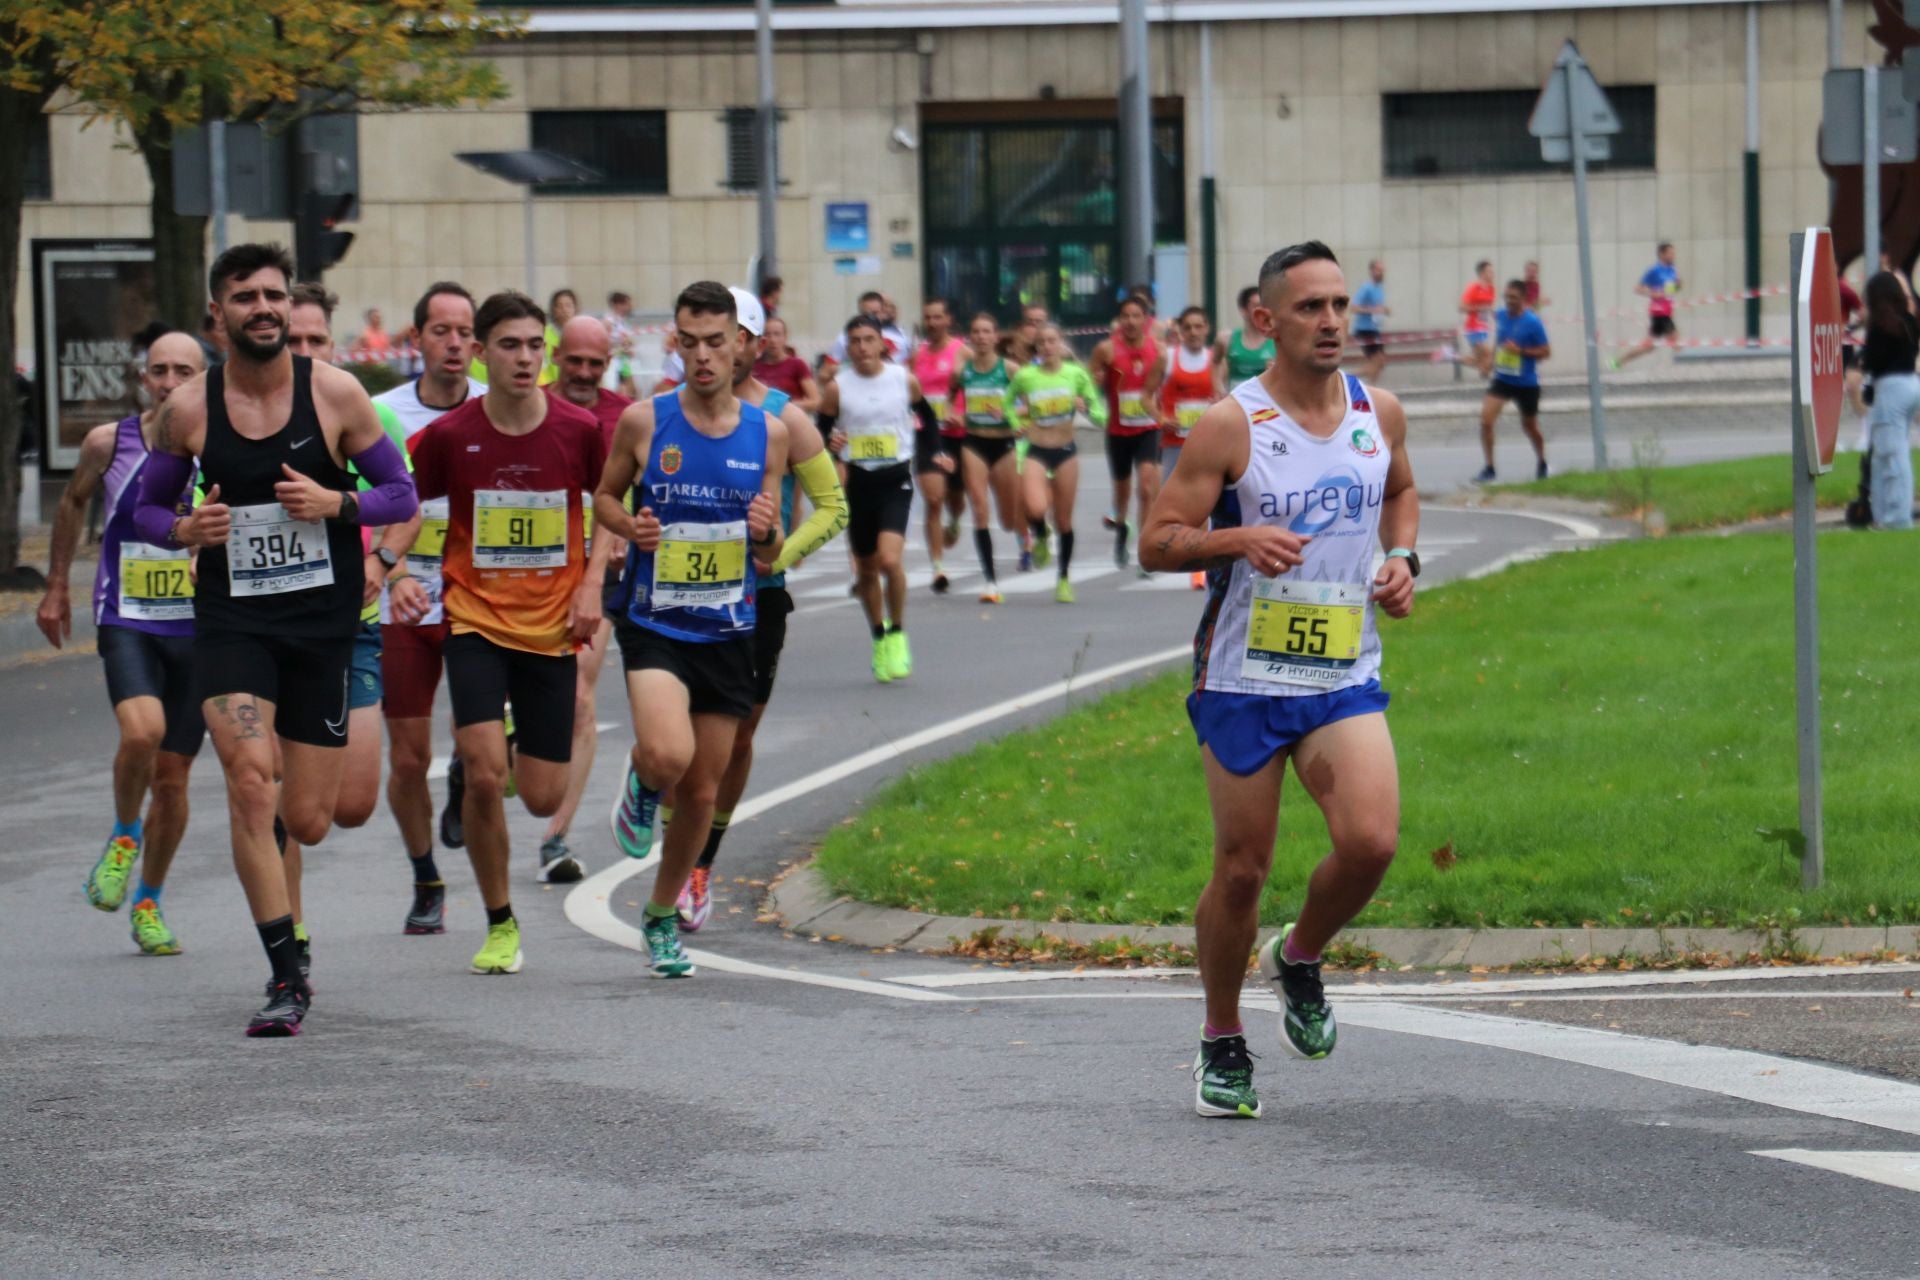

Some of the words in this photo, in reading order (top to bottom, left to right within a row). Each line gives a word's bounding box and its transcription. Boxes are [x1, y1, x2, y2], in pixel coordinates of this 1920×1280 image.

[1813, 323, 1841, 377] STOP
[509, 518, 533, 546] 91
[249, 531, 305, 569] 394
[686, 552, 718, 581] 34
[145, 569, 184, 597] 102
[1286, 616, 1328, 656] 55
